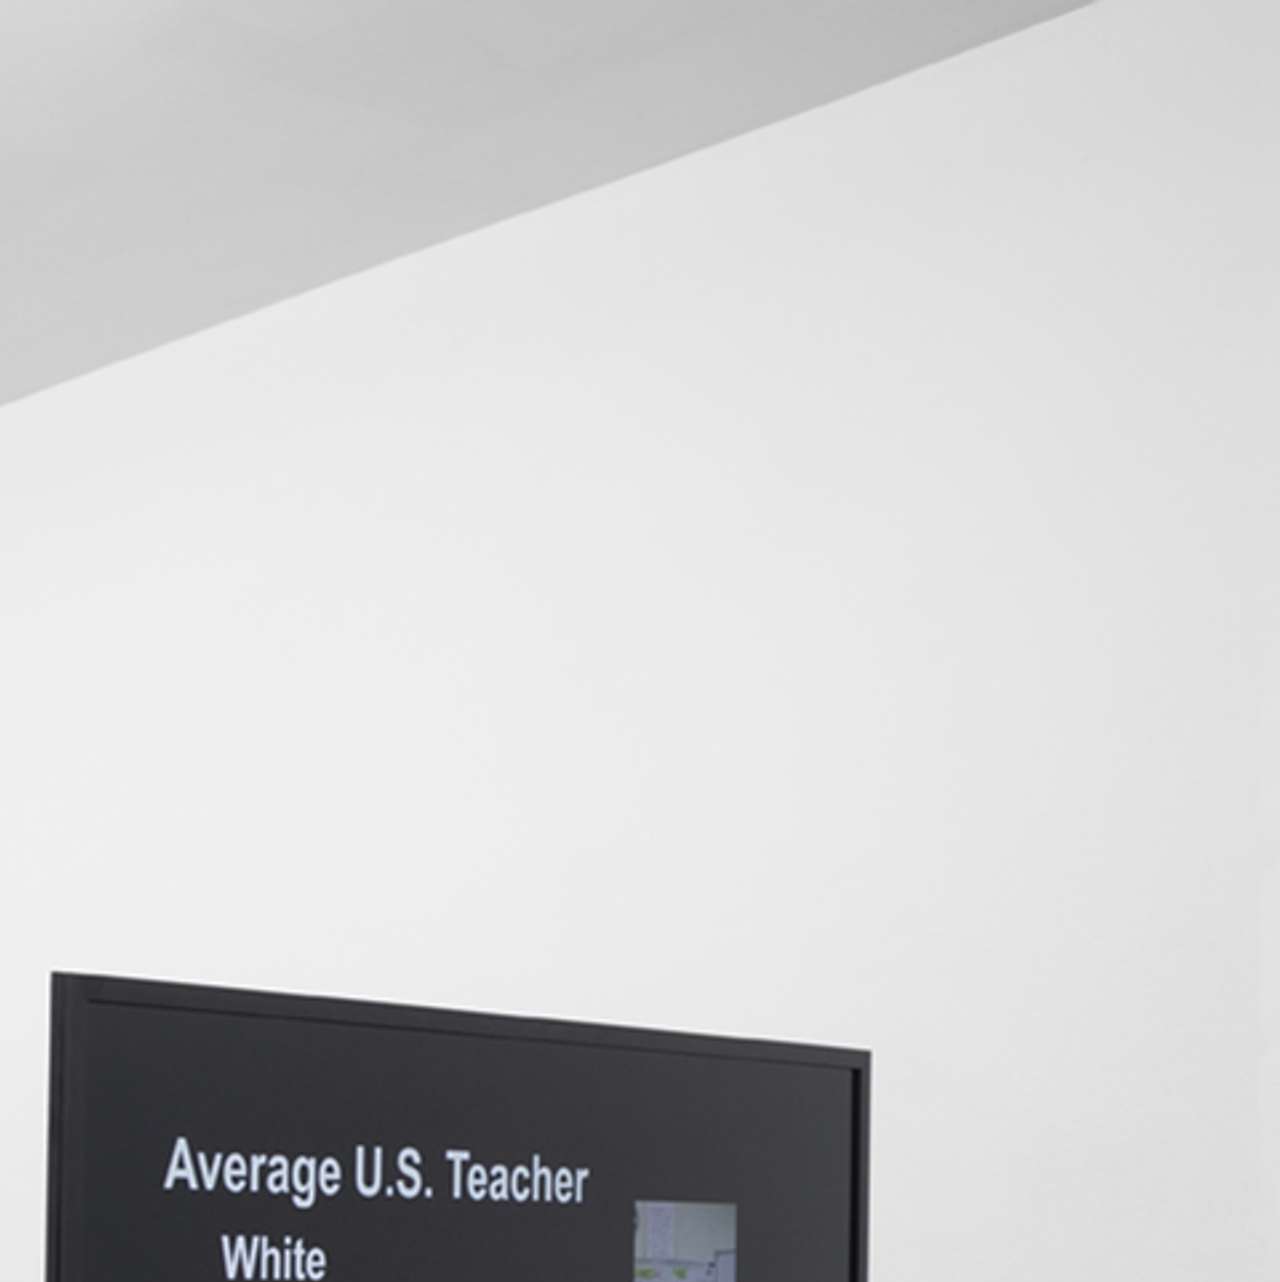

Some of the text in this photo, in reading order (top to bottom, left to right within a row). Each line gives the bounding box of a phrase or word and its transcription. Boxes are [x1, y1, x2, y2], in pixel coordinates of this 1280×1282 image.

[163, 1136, 590, 1209] Average U.S. Teacher
[221, 1234, 327, 1281] White
